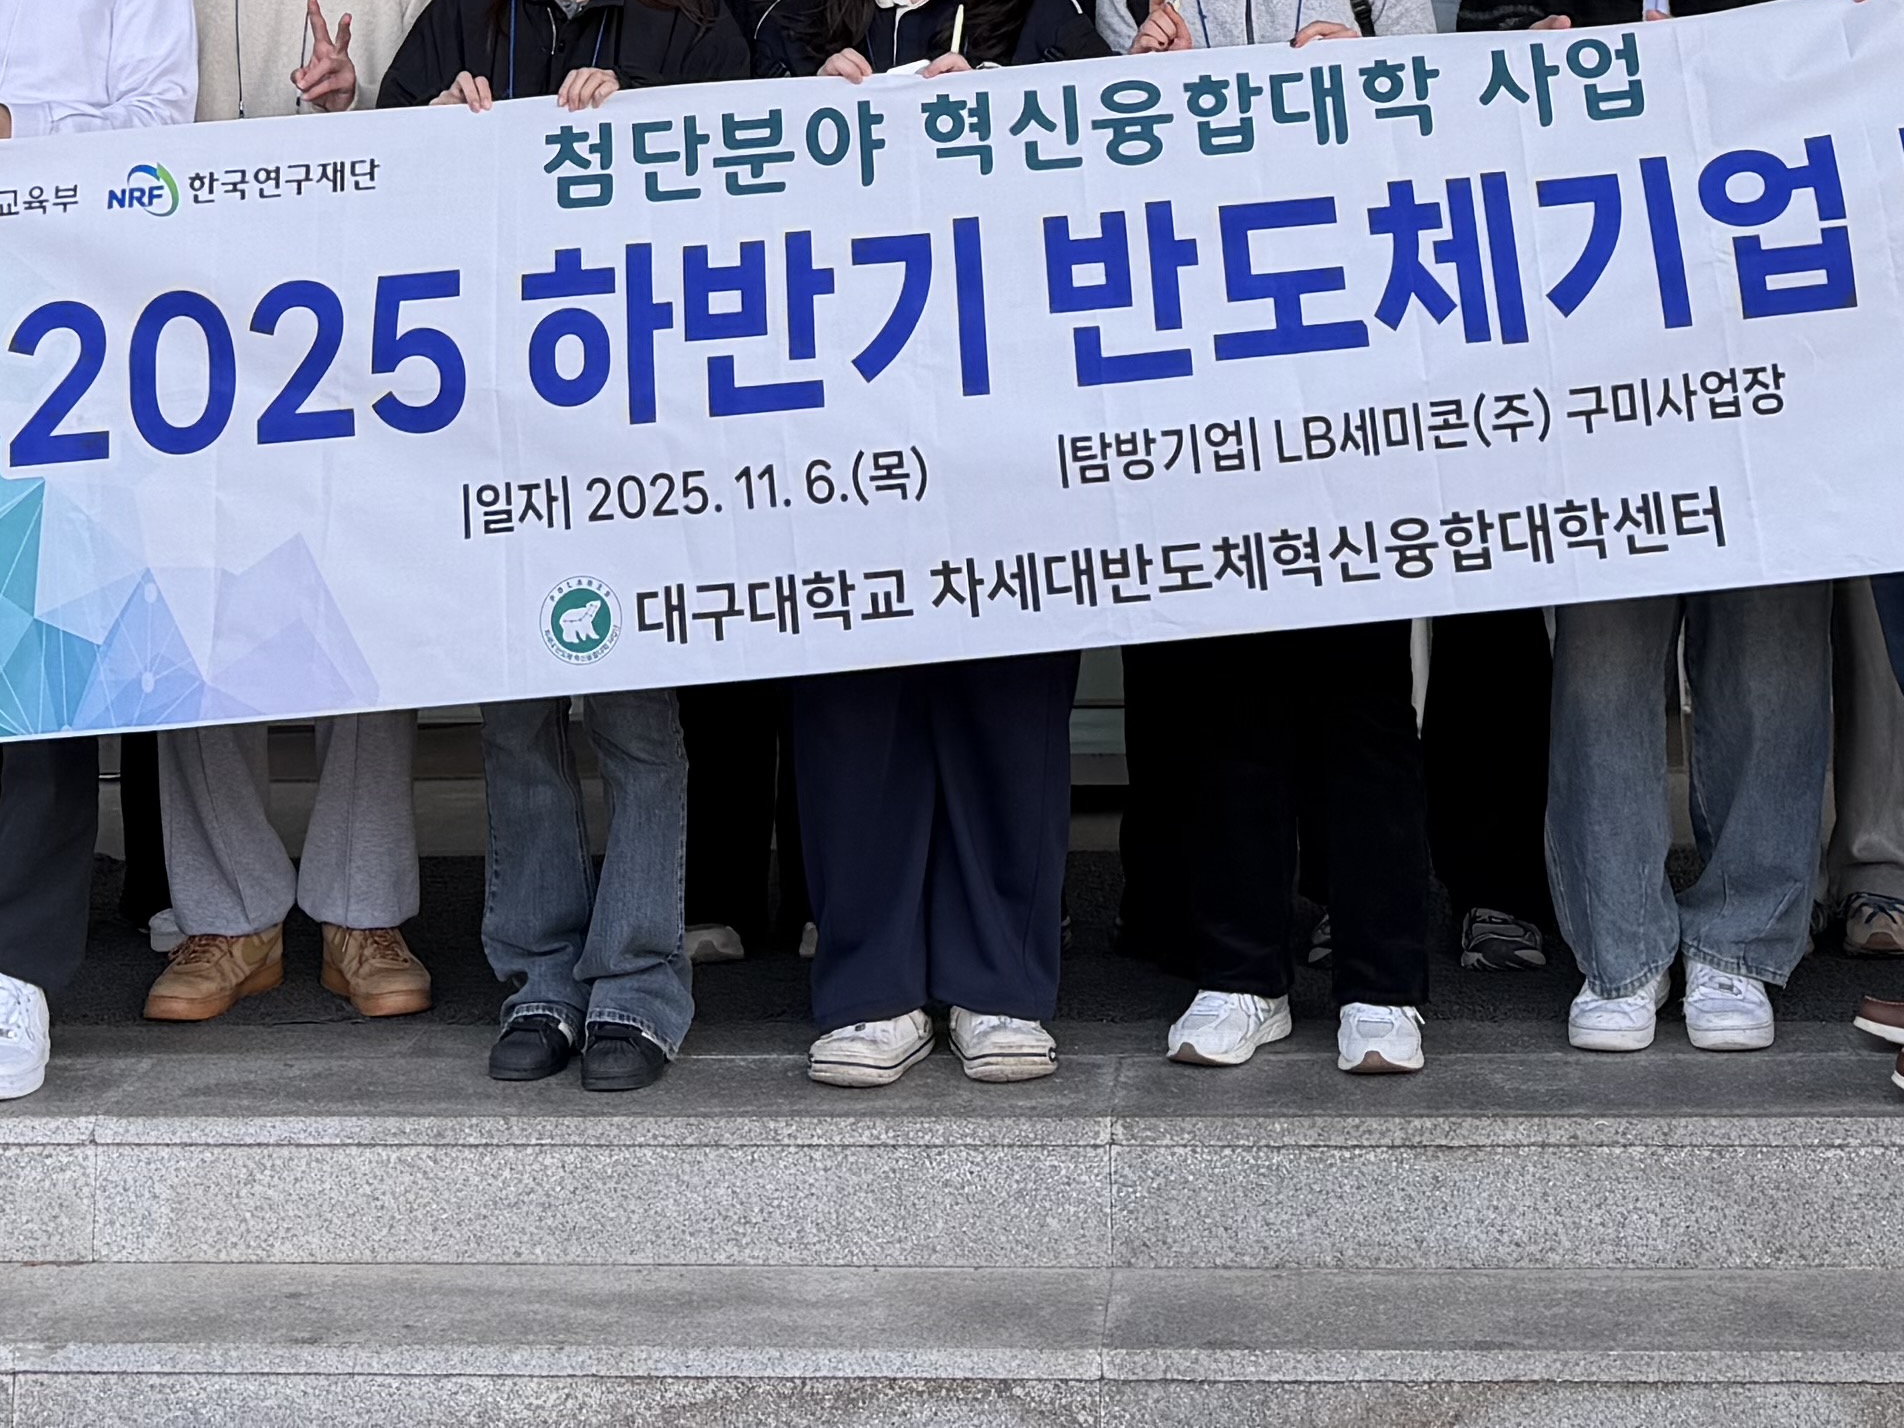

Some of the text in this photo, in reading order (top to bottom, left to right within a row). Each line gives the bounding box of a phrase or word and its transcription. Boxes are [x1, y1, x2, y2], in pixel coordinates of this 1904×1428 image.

[107, 158, 380, 210] NRF 한국연구재단
[544, 33, 1644, 208] 첨단분야 혁신융합대학 사업
[10, 270, 466, 467] 2025
[522, 218, 990, 424] 하반기
[1044, 136, 1855, 386] 반도체기업
[1275, 389, 1550, 462] LB세미콘(주)
[1568, 364, 1785, 433] 구미사업장
[587, 471, 721, 521] 2025.
[735, 465, 790, 509] 11.
[806, 446, 926, 505] 6.(목)
[637, 487, 1725, 643] 대구대학교 차세대반도체혁신융합대학센터
